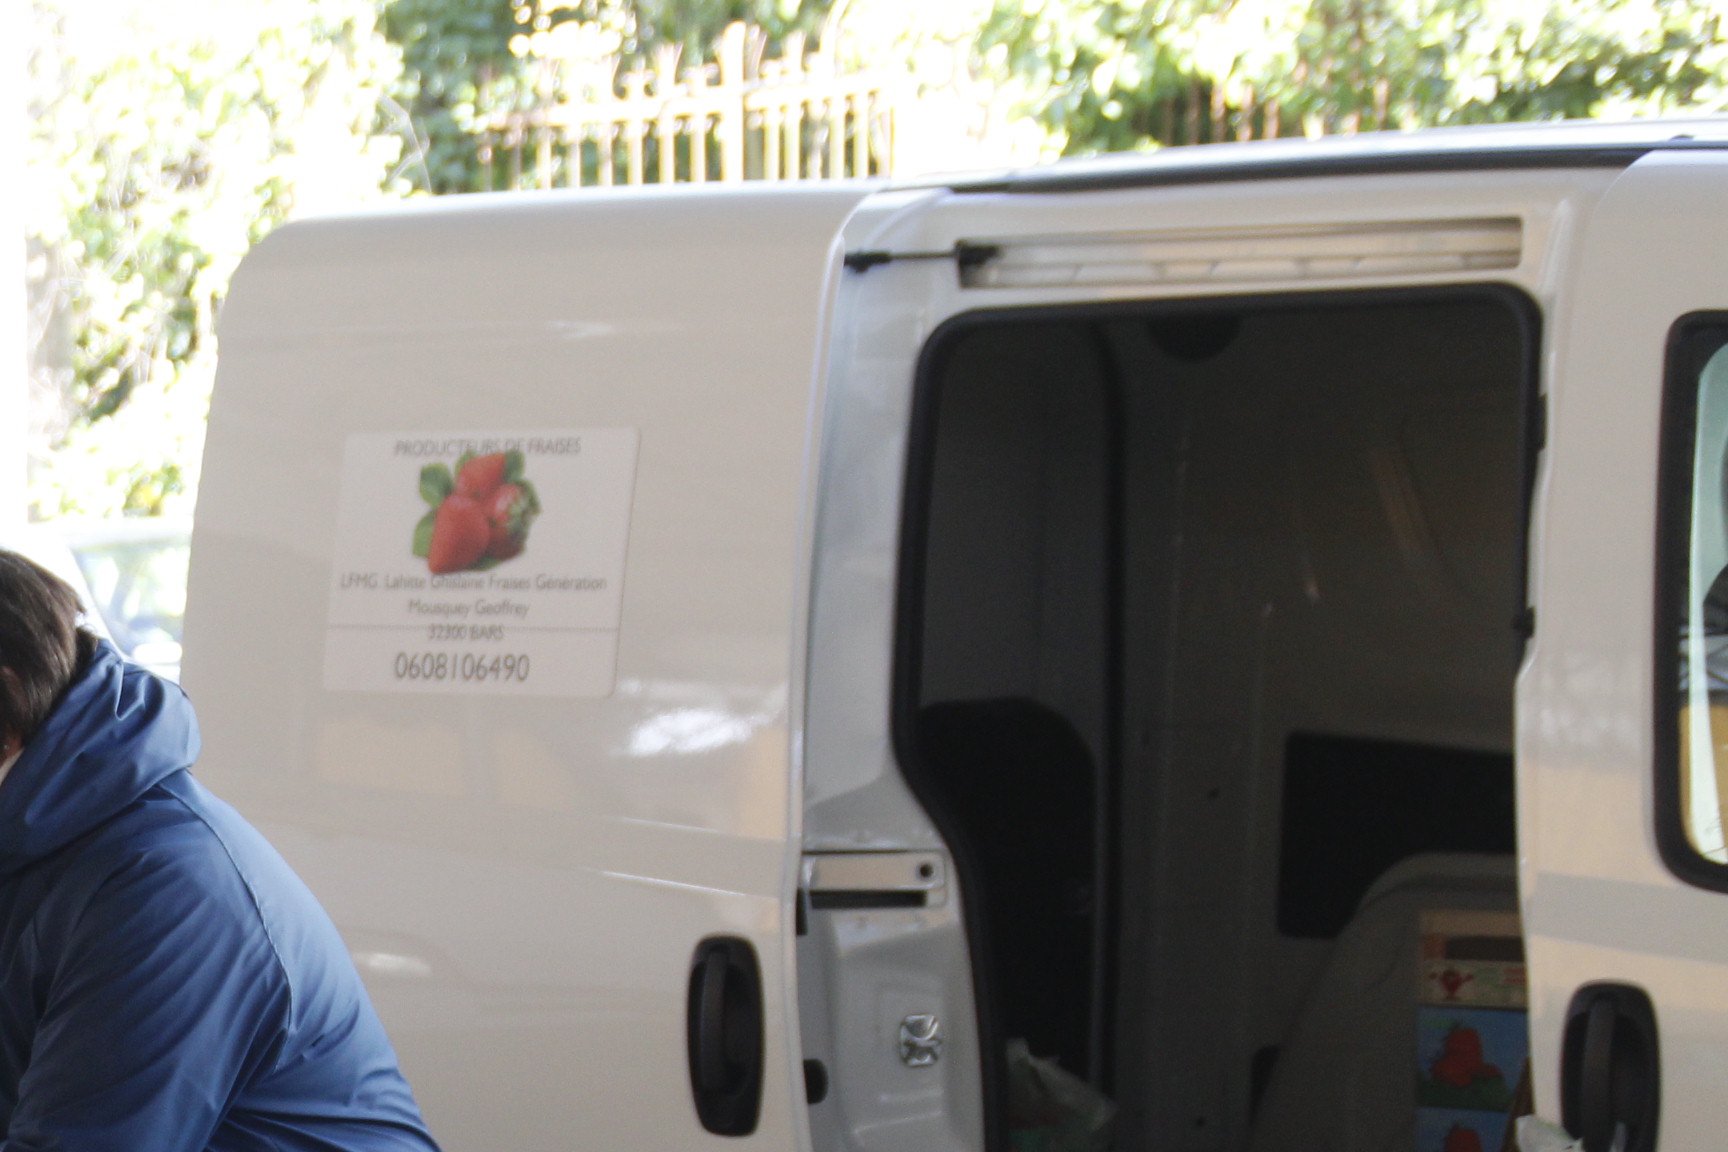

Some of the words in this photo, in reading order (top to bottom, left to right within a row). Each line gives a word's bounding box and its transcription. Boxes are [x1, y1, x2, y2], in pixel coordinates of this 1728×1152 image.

[527, 437, 582, 455] FRAISES
[384, 573, 426, 590] Lahitte
[430, 574, 484, 590] Ghislaine
[488, 574, 531, 590] Fraises
[408, 599, 470, 618] Mousquey
[474, 599, 530, 618] Geoffrey
[427, 624, 467, 640] 32300
[469, 624, 505, 641] BARS
[393, 651, 531, 681] 0608106490
